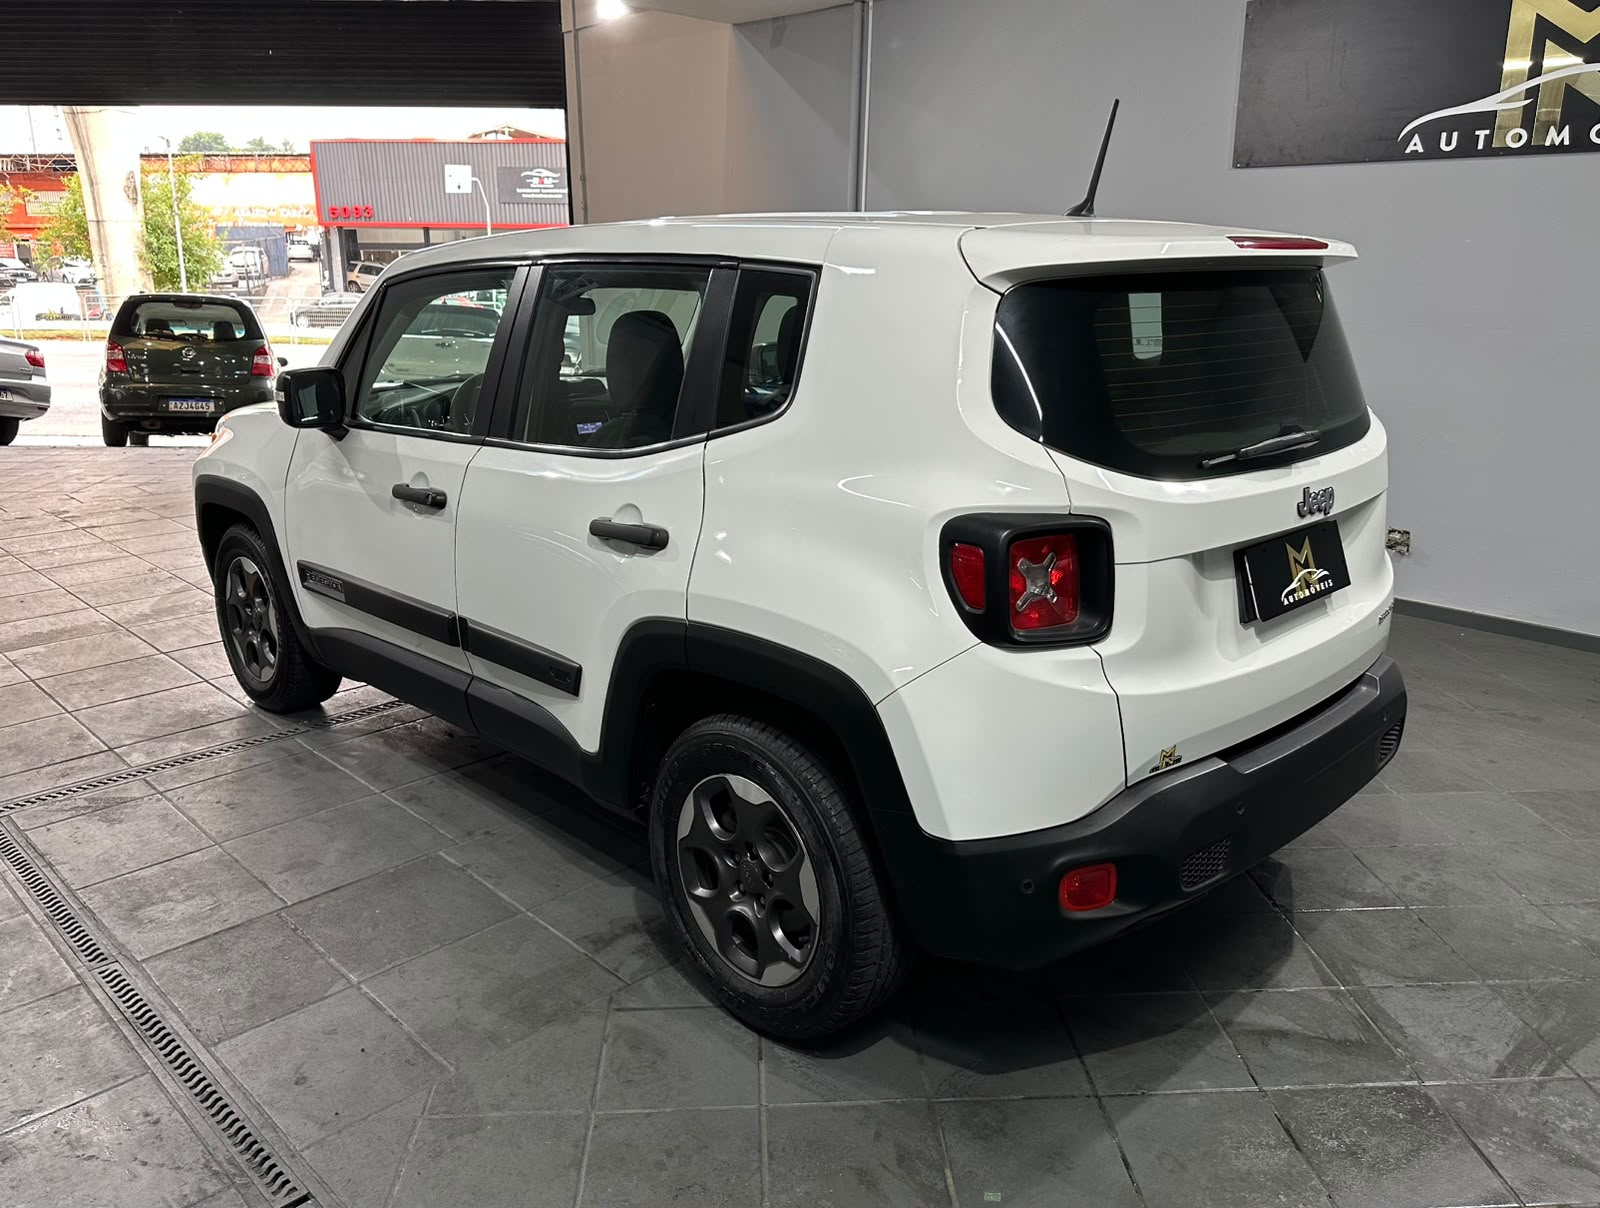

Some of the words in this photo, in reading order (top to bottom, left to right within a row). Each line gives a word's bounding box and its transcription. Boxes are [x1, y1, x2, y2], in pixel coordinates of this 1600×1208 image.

[329, 205, 374, 219] 5093
[174, 402, 210, 410] AZJ4G45
[1297, 487, 1334, 518] Jeep
